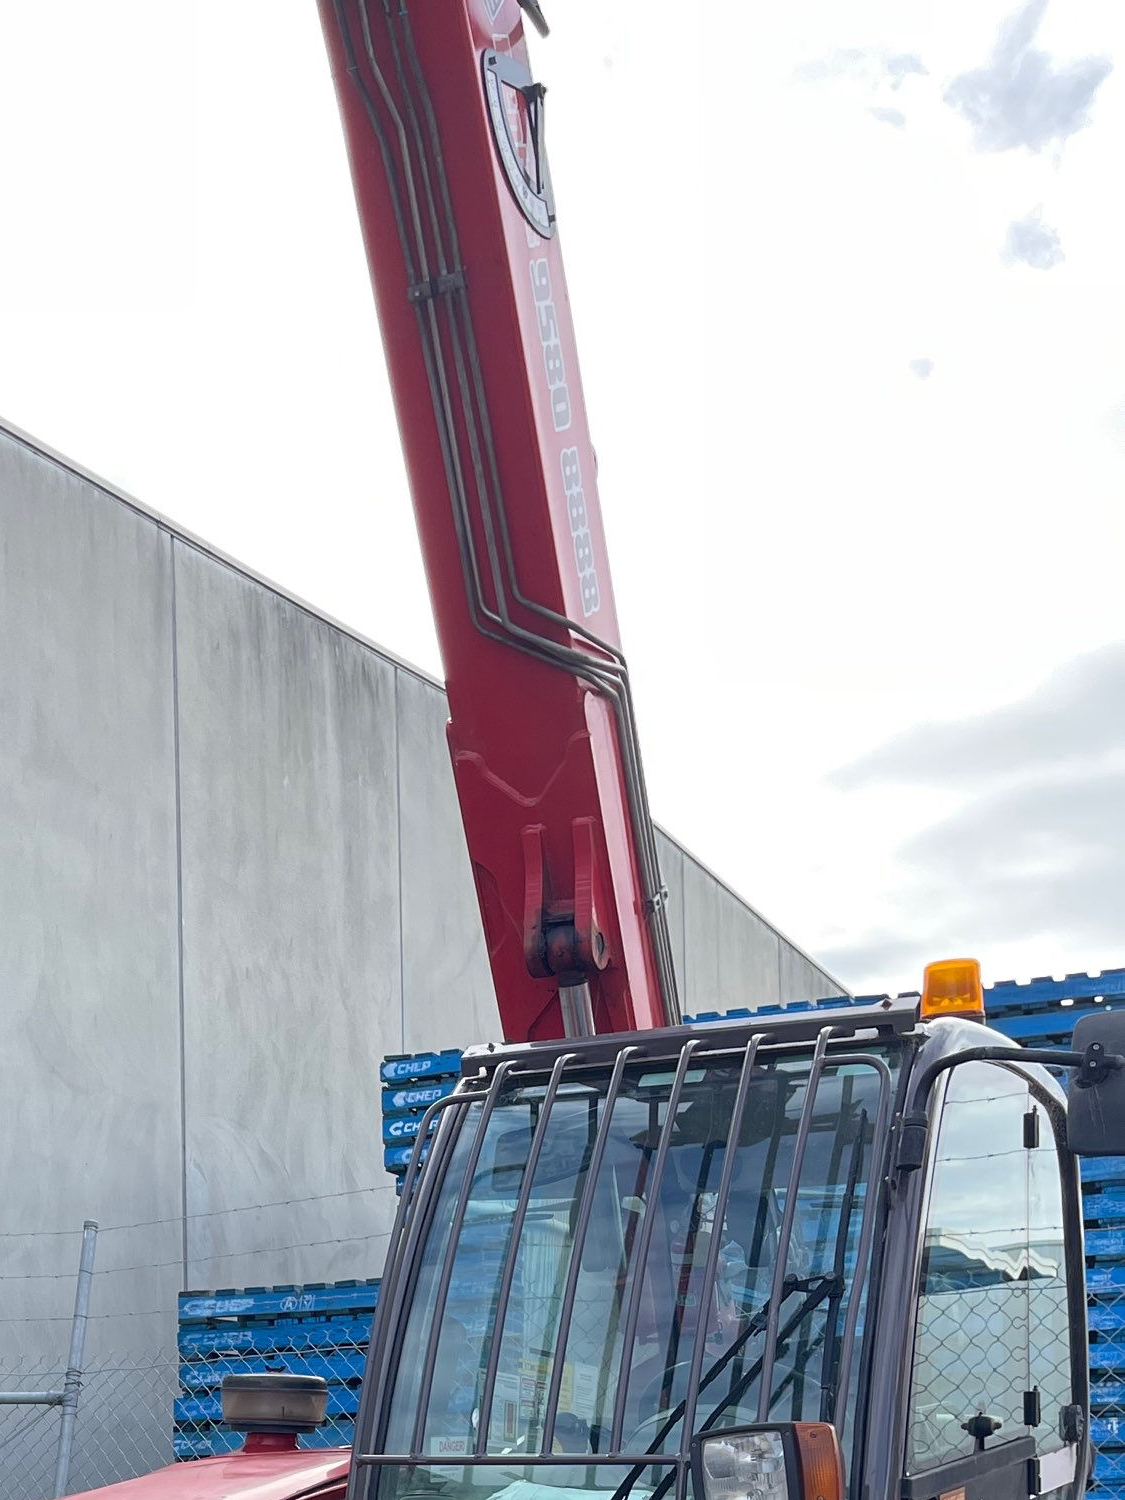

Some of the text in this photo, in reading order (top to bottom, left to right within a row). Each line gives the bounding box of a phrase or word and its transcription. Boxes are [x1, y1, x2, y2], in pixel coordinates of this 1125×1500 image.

[530, 258, 601, 618] 9580 8888
[403, 1119, 438, 1132] CHP
[439, 1440, 465, 1452] DANGER
